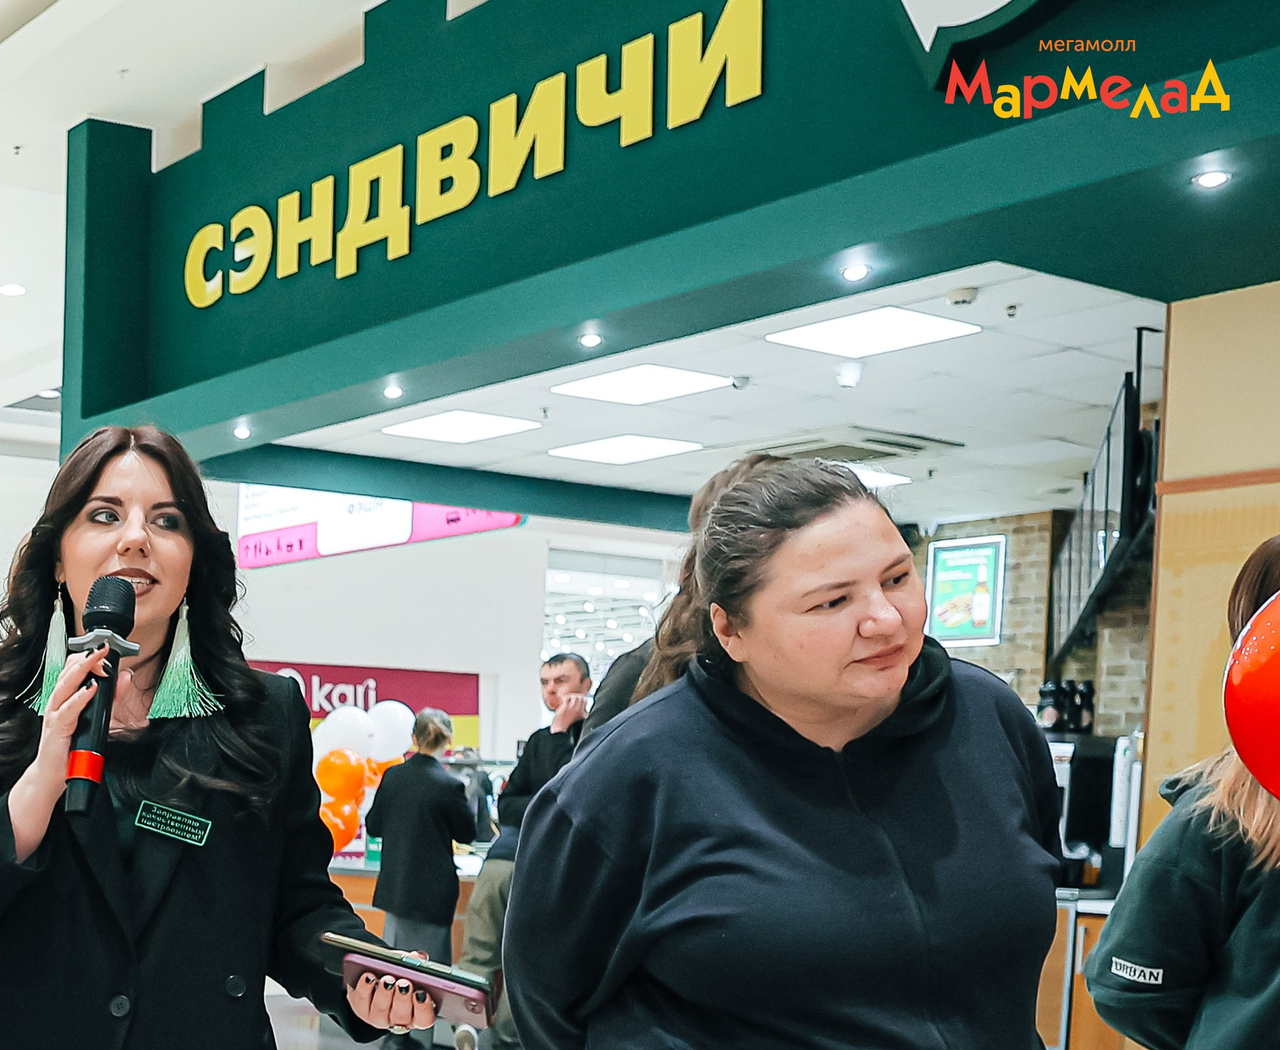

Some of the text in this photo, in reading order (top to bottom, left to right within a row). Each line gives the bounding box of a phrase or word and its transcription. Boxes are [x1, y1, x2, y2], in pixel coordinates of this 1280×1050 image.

[184, 0, 764, 309] СЭНДВИЧИ
[311, 675, 377, 713] kari
[1114, 960, 1160, 982] URBAN
